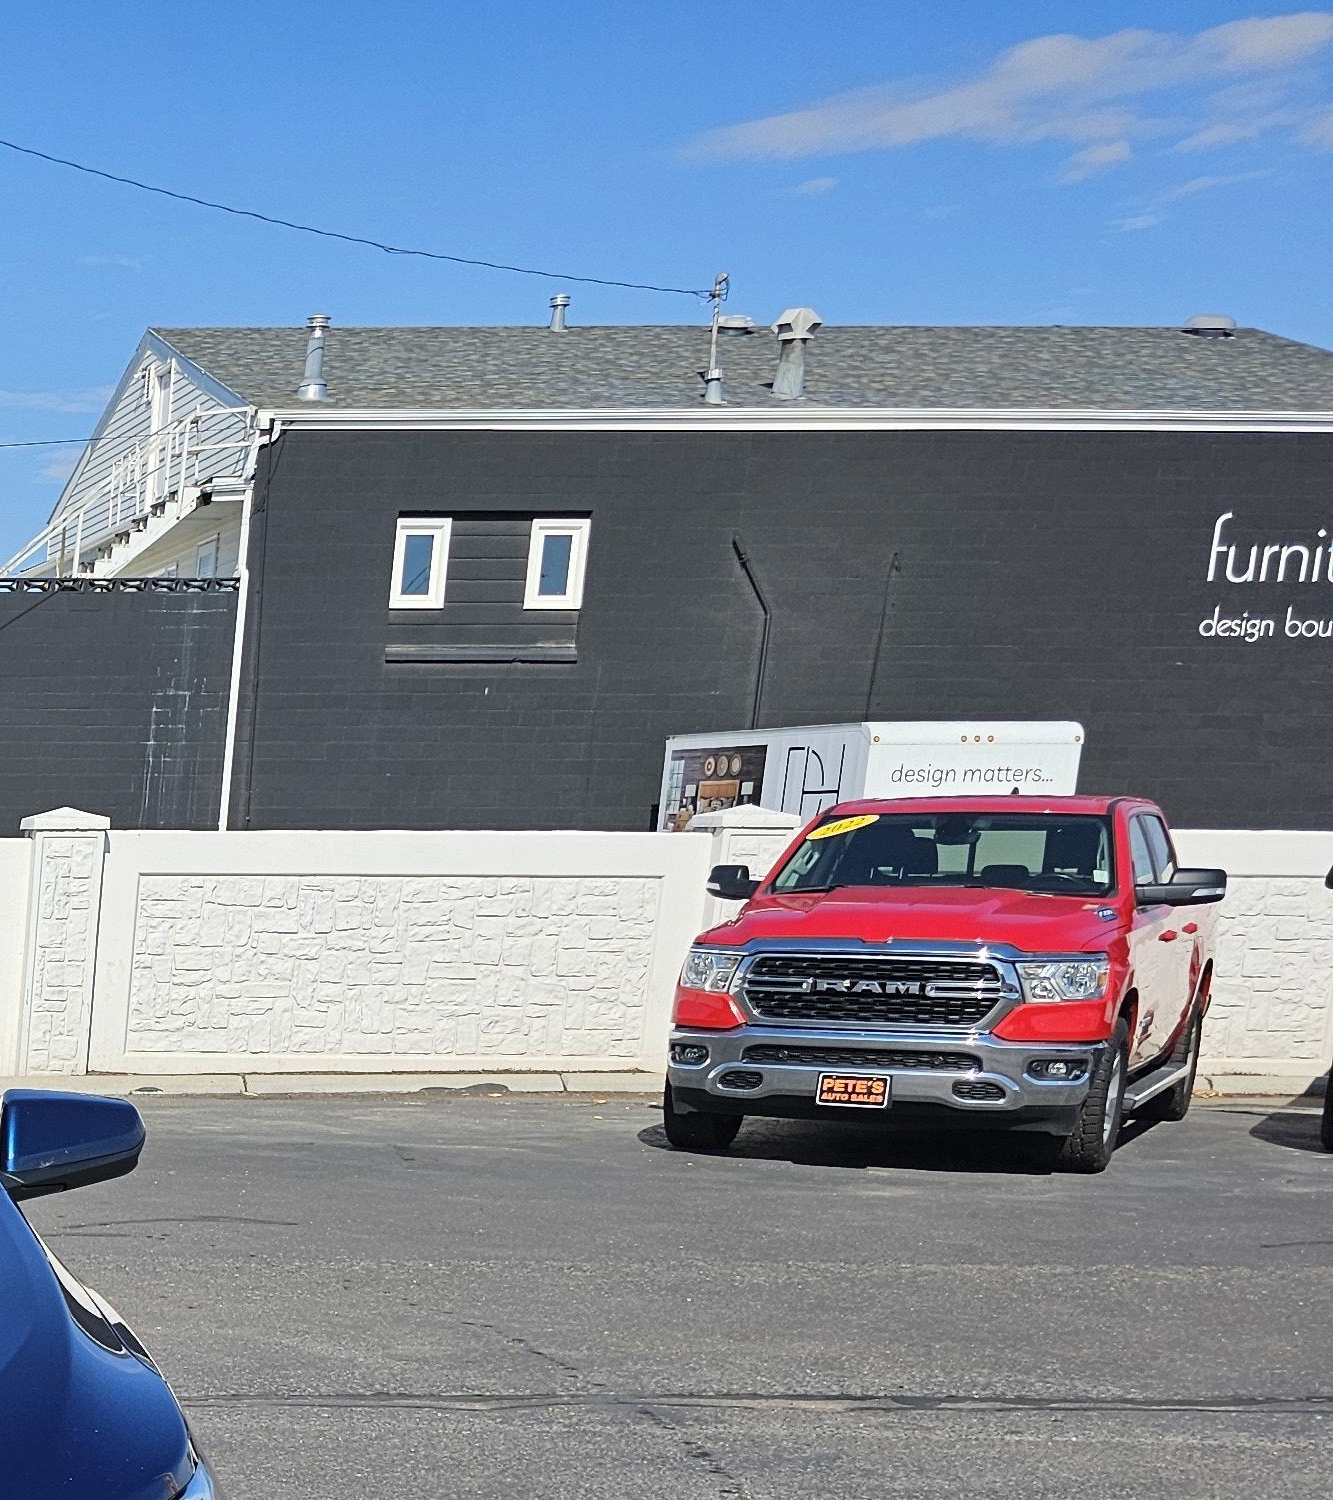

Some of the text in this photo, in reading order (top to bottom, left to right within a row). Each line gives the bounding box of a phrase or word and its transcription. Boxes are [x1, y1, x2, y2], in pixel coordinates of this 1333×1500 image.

[1198, 604, 1275, 643] design
[891, 764, 1054, 787] design matters...
[816, 979, 921, 995] RAM
[822, 1078, 885, 1094] PETE'S
[820, 1091, 884, 1103] AUTO SALES
